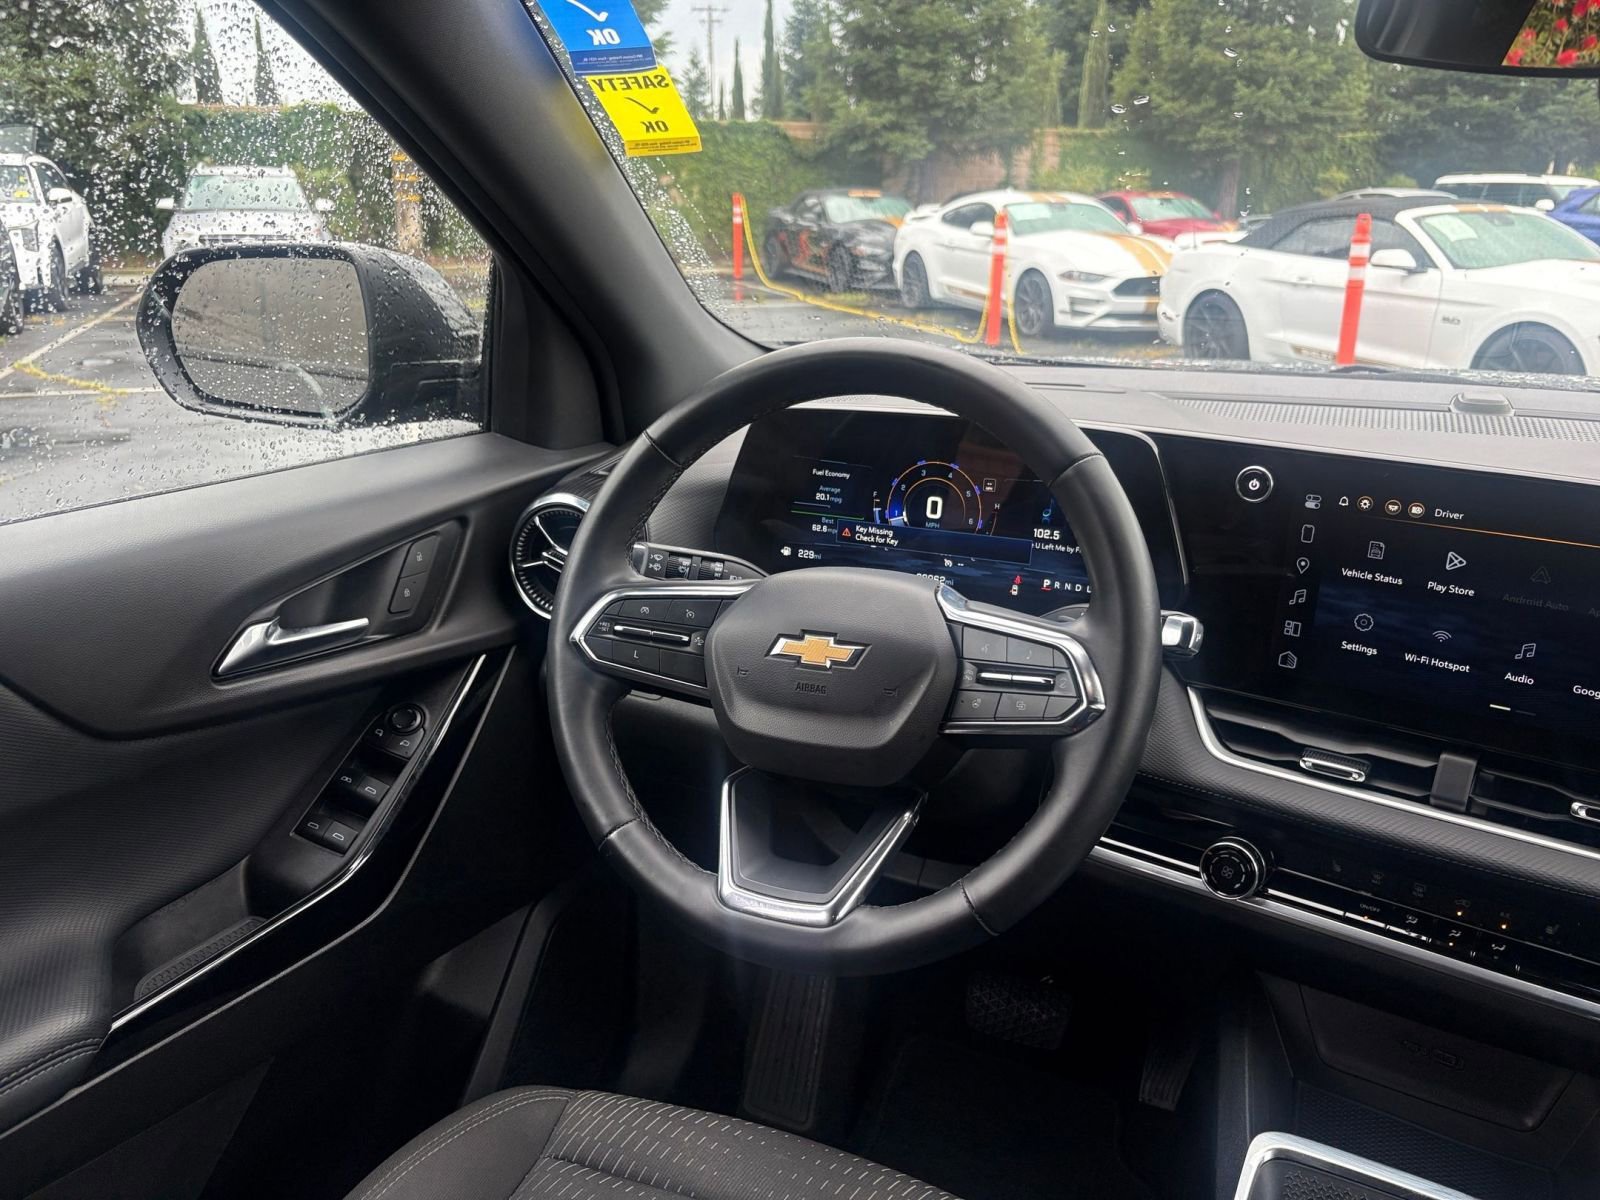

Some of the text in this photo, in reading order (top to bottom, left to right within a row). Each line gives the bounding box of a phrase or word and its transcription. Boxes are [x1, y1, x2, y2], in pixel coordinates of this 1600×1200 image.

[826, 470, 850, 480] Economy
[819, 485, 841, 494] Average
[965, 490, 971, 498] 5
[926, 496, 943, 519] 0
[1434, 508, 1464, 520] Driver
[821, 517, 834, 525] Best
[855, 525, 893, 537] Key Missing
[1034, 528, 1060, 540] 102.5
[855, 534, 899, 546] Check for Key
[1067, 545, 1074, 554] by
[1342, 567, 1403, 585] Vehicle Status
[1043, 579, 1051, 588] P
[1054, 581, 1060, 589] R
[1427, 581, 1475, 597] Play Store
[1502, 594, 1569, 611] Android Auto
[1341, 640, 1377, 655] Settings
[1404, 653, 1470, 673] Wi-Fi Hotspot
[1504, 672, 1534, 685] Audio
[795, 682, 827, 694] AIRBAG
